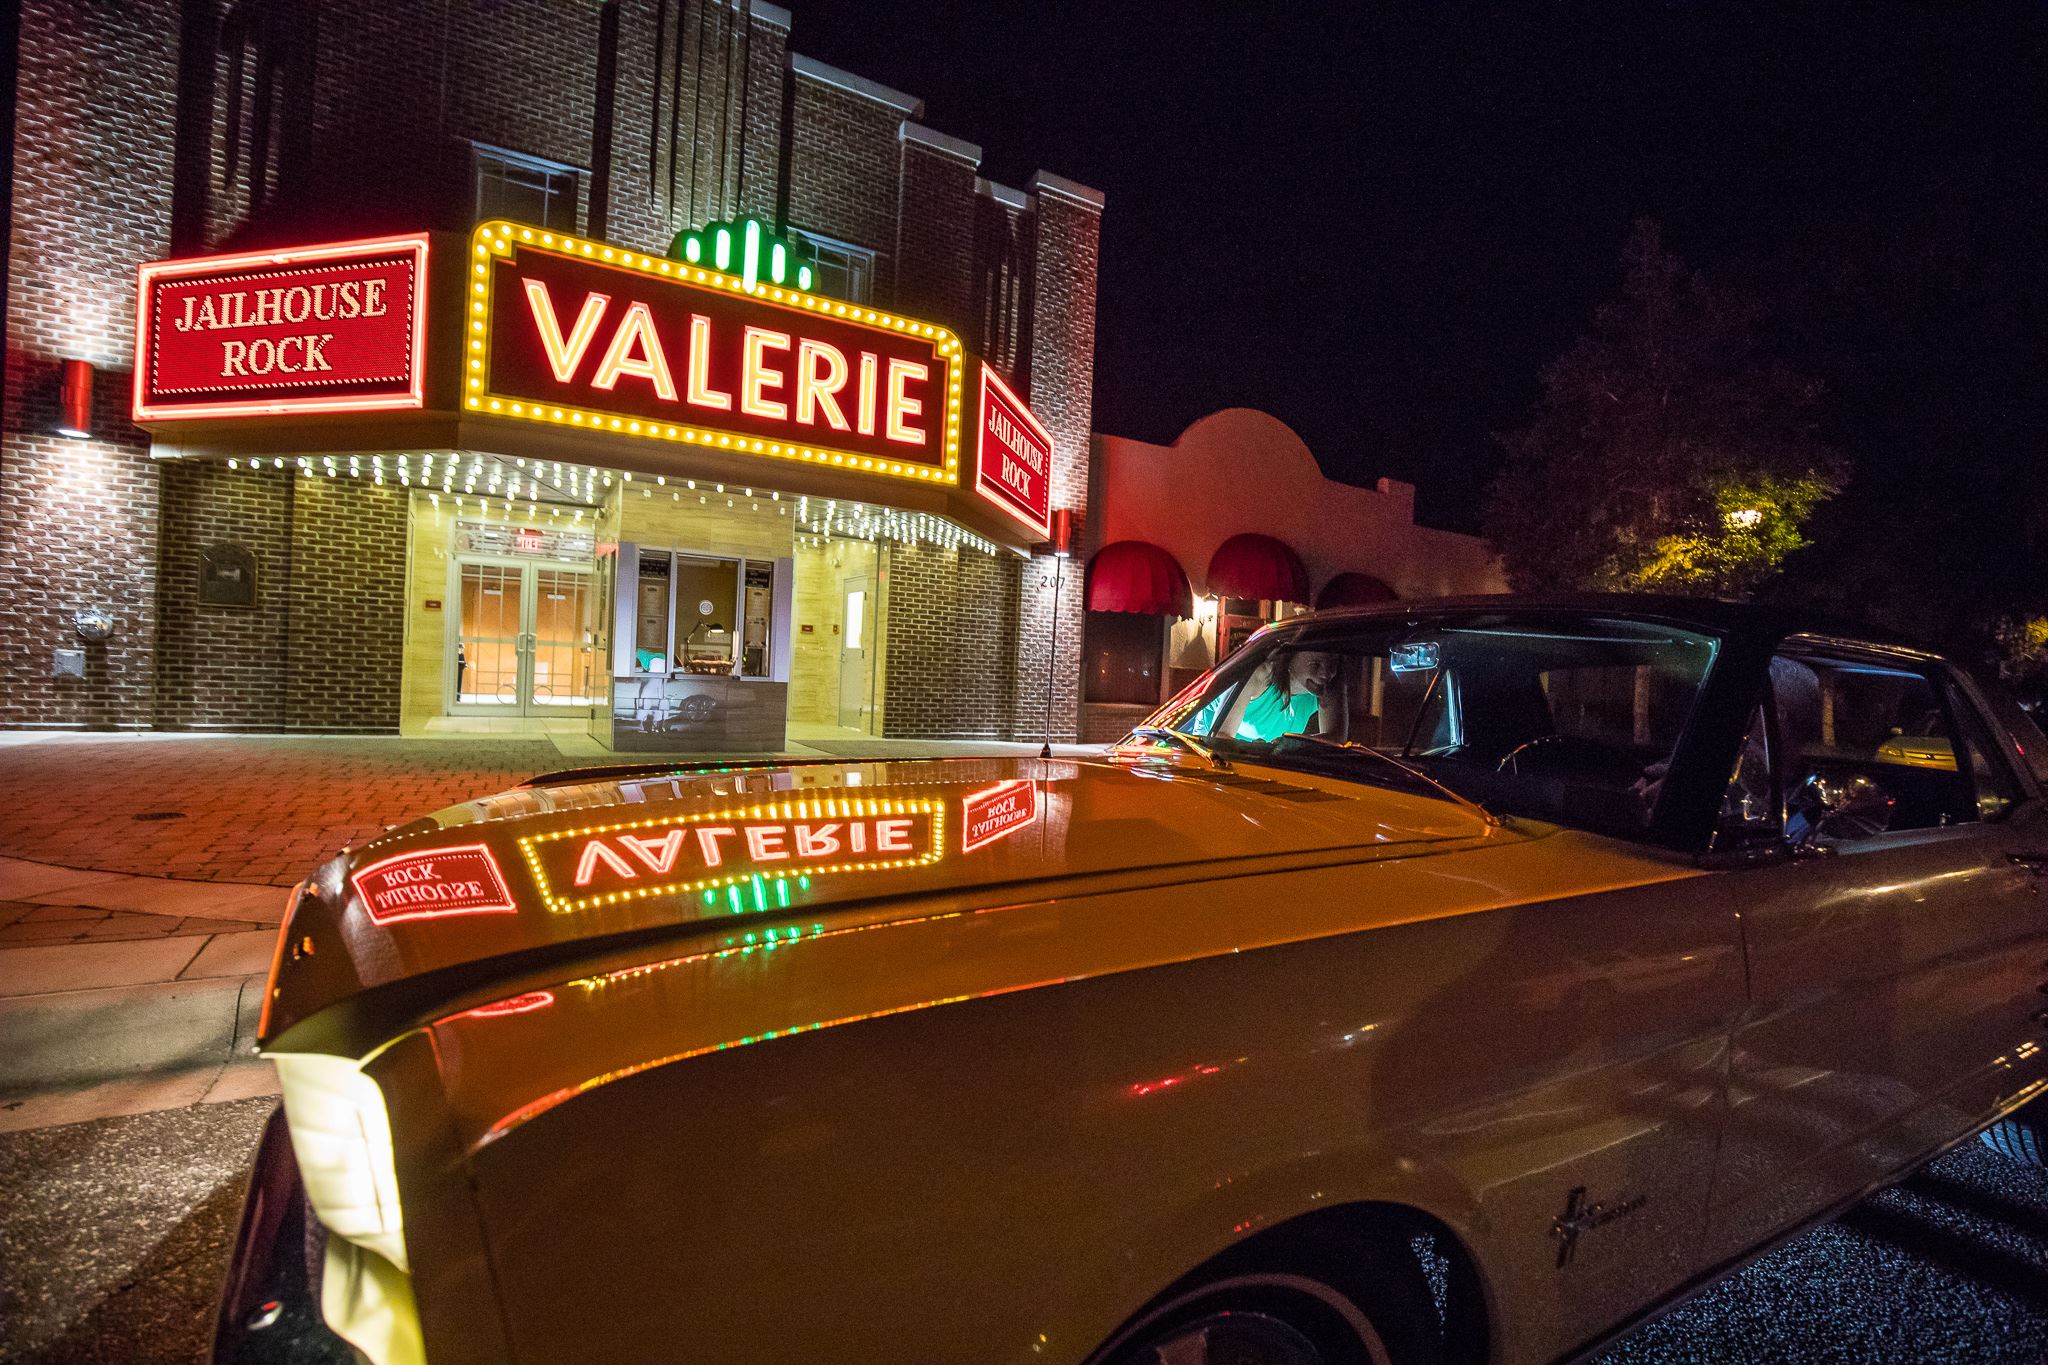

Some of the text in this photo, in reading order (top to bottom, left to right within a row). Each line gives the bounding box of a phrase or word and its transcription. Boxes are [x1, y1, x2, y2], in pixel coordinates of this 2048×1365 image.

[175, 278, 387, 332] JAILHOUSE
[220, 333, 334, 377] ROCK
[521, 277, 929, 446] VALERIE
[988, 405, 1044, 476] JAILHOUSE
[1001, 454, 1031, 499] ROCK
[1041, 575, 1065, 589] 207
